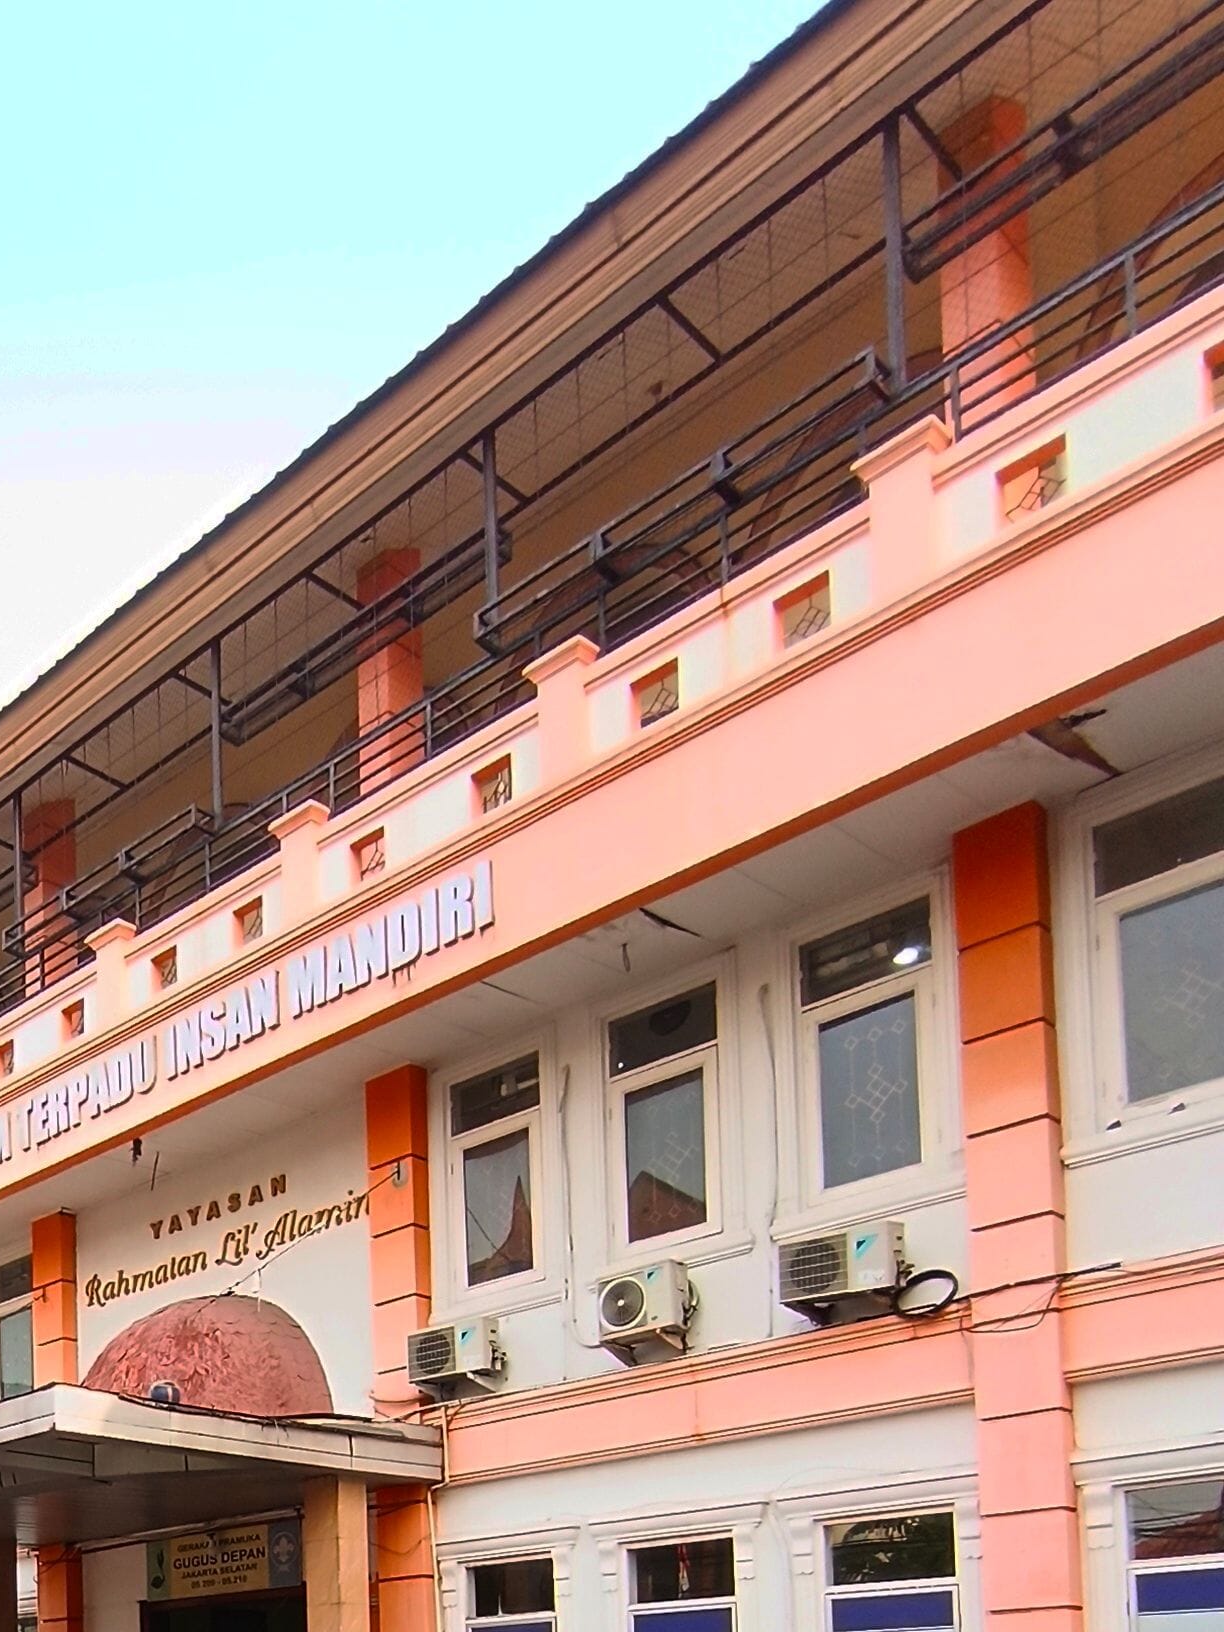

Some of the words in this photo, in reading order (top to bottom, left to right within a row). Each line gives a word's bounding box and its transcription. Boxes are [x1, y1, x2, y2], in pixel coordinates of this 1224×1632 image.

[16, 1036, 157, 1152] TERPADU
[164, 969, 280, 1081] INSAN
[287, 860, 495, 1019] MANDIRI
[150, 1174, 286, 1239] YAYASAN
[256, 1190, 369, 1260] Alamin
[174, 1554, 217, 1570] GUGUS
[221, 1547, 265, 1563] DEPAN
[182, 1568, 218, 1579] JAKARTA
[220, 1563, 257, 1575] SELATAN
